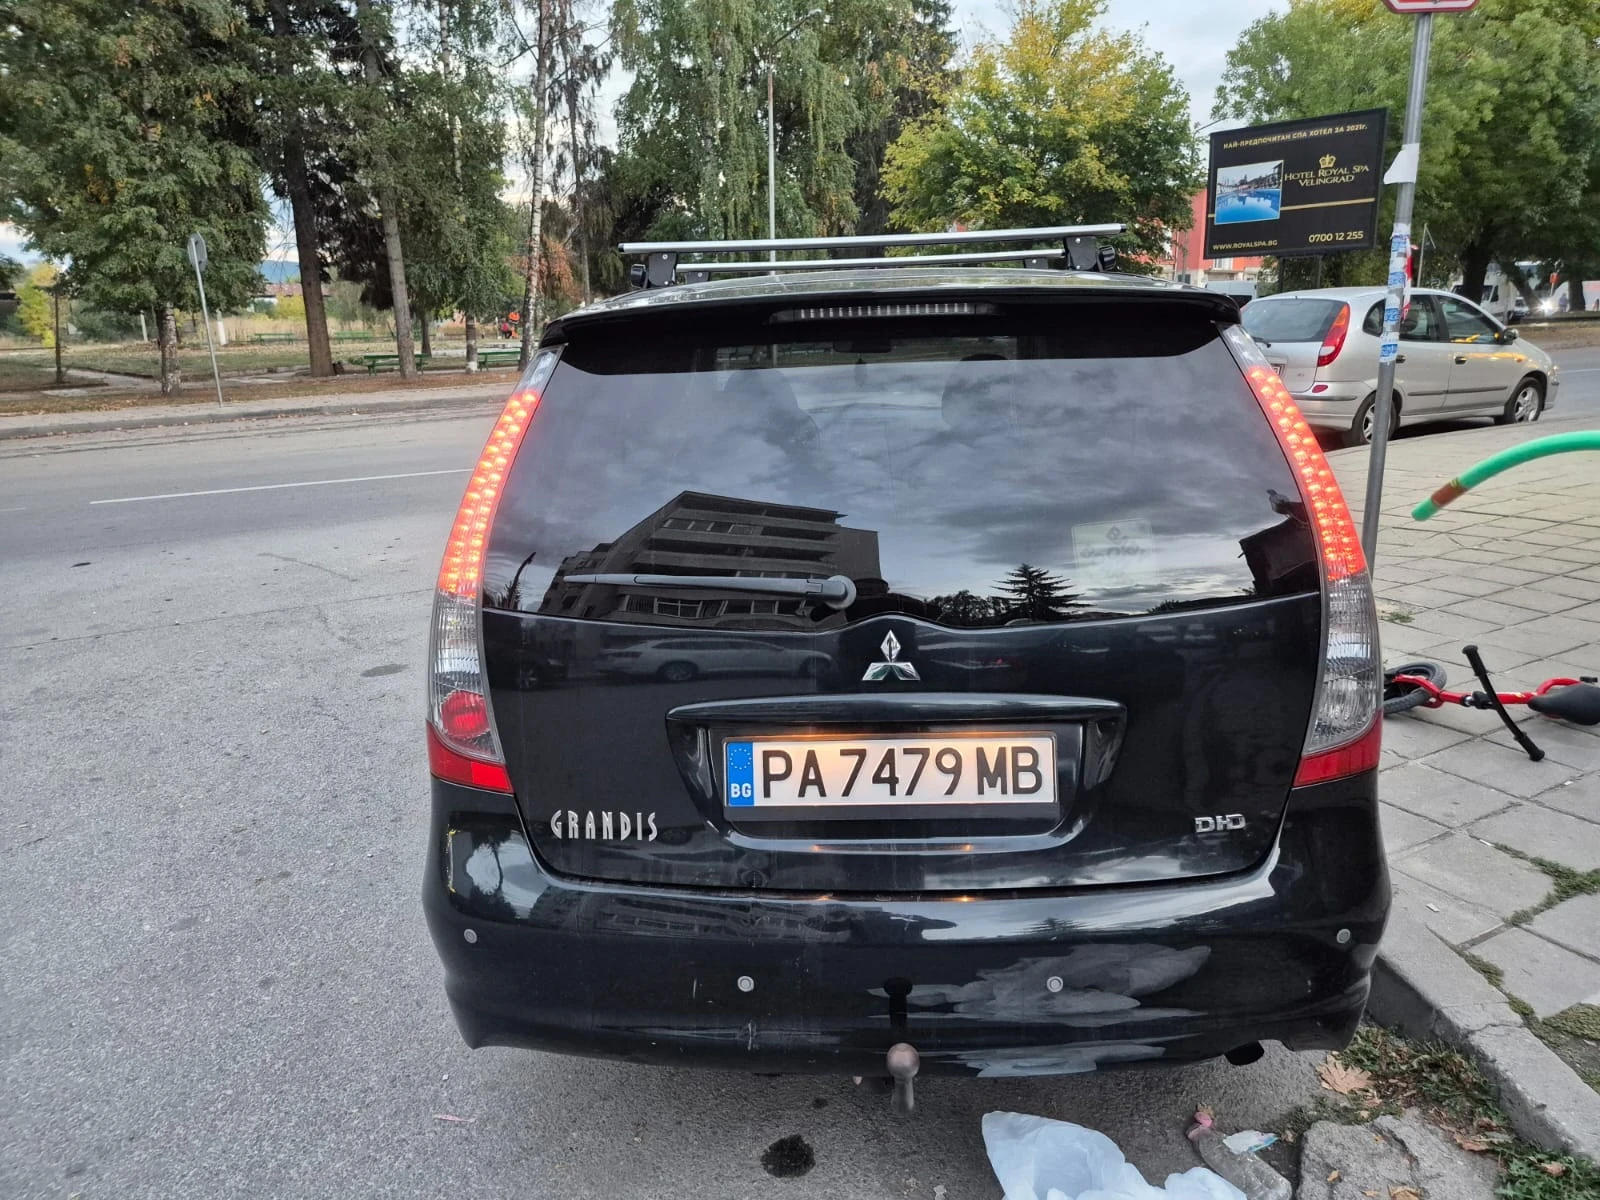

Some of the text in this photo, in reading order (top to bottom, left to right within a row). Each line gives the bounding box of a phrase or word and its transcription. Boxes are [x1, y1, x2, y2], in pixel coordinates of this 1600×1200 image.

[1223, 133, 1291, 149] НАЙ-ПРЕДПОЧИТАН
[1292, 131, 1307, 139] СПА
[1309, 129, 1333, 137] ХОТЕЛ
[1284, 164, 1370, 181] HOTEL ROYAL SPA
[1298, 175, 1355, 187] VELINGRAD
[1212, 239, 1278, 250] WWW.ROYALSPA.BG
[1308, 231, 1364, 243] 0700 12 255
[761, 745, 1043, 799] PA 7479 MB
[730, 783, 752, 798] BG
[550, 809, 658, 842] GRANDIS
